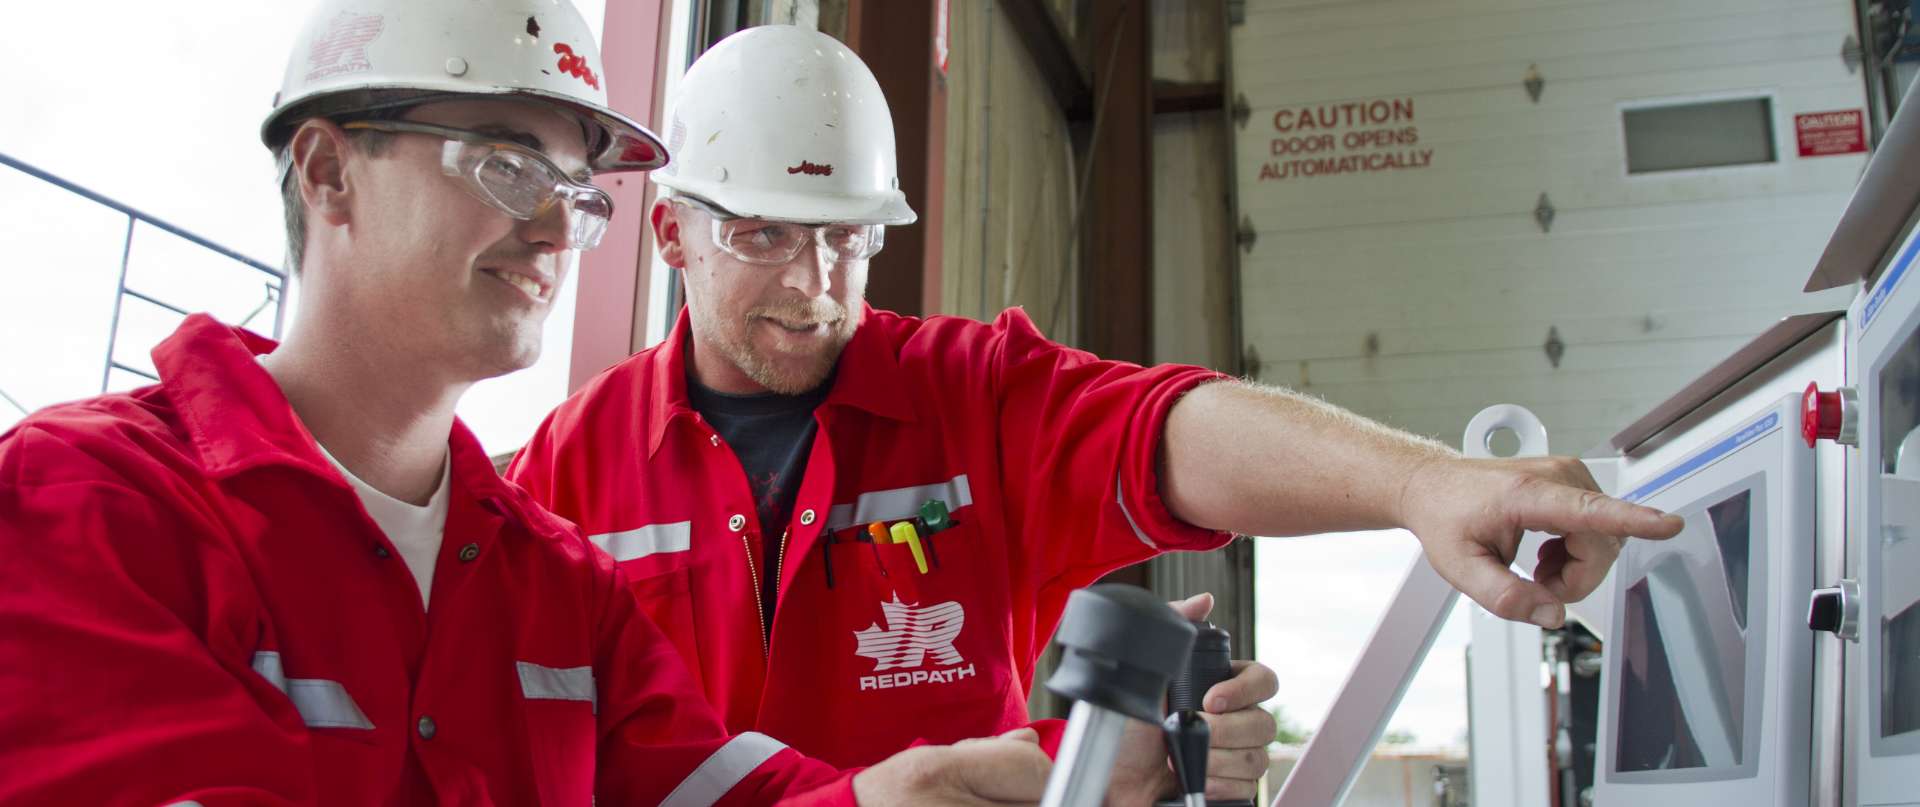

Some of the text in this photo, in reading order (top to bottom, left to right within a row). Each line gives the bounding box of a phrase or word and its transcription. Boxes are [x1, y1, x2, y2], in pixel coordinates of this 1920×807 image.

[1274, 98, 1413, 132] CAUTION
[1271, 127, 1418, 156] DOOR OPENS
[1259, 149, 1432, 181] AUTOMATICALLY
[860, 663, 976, 690] REDPATH
